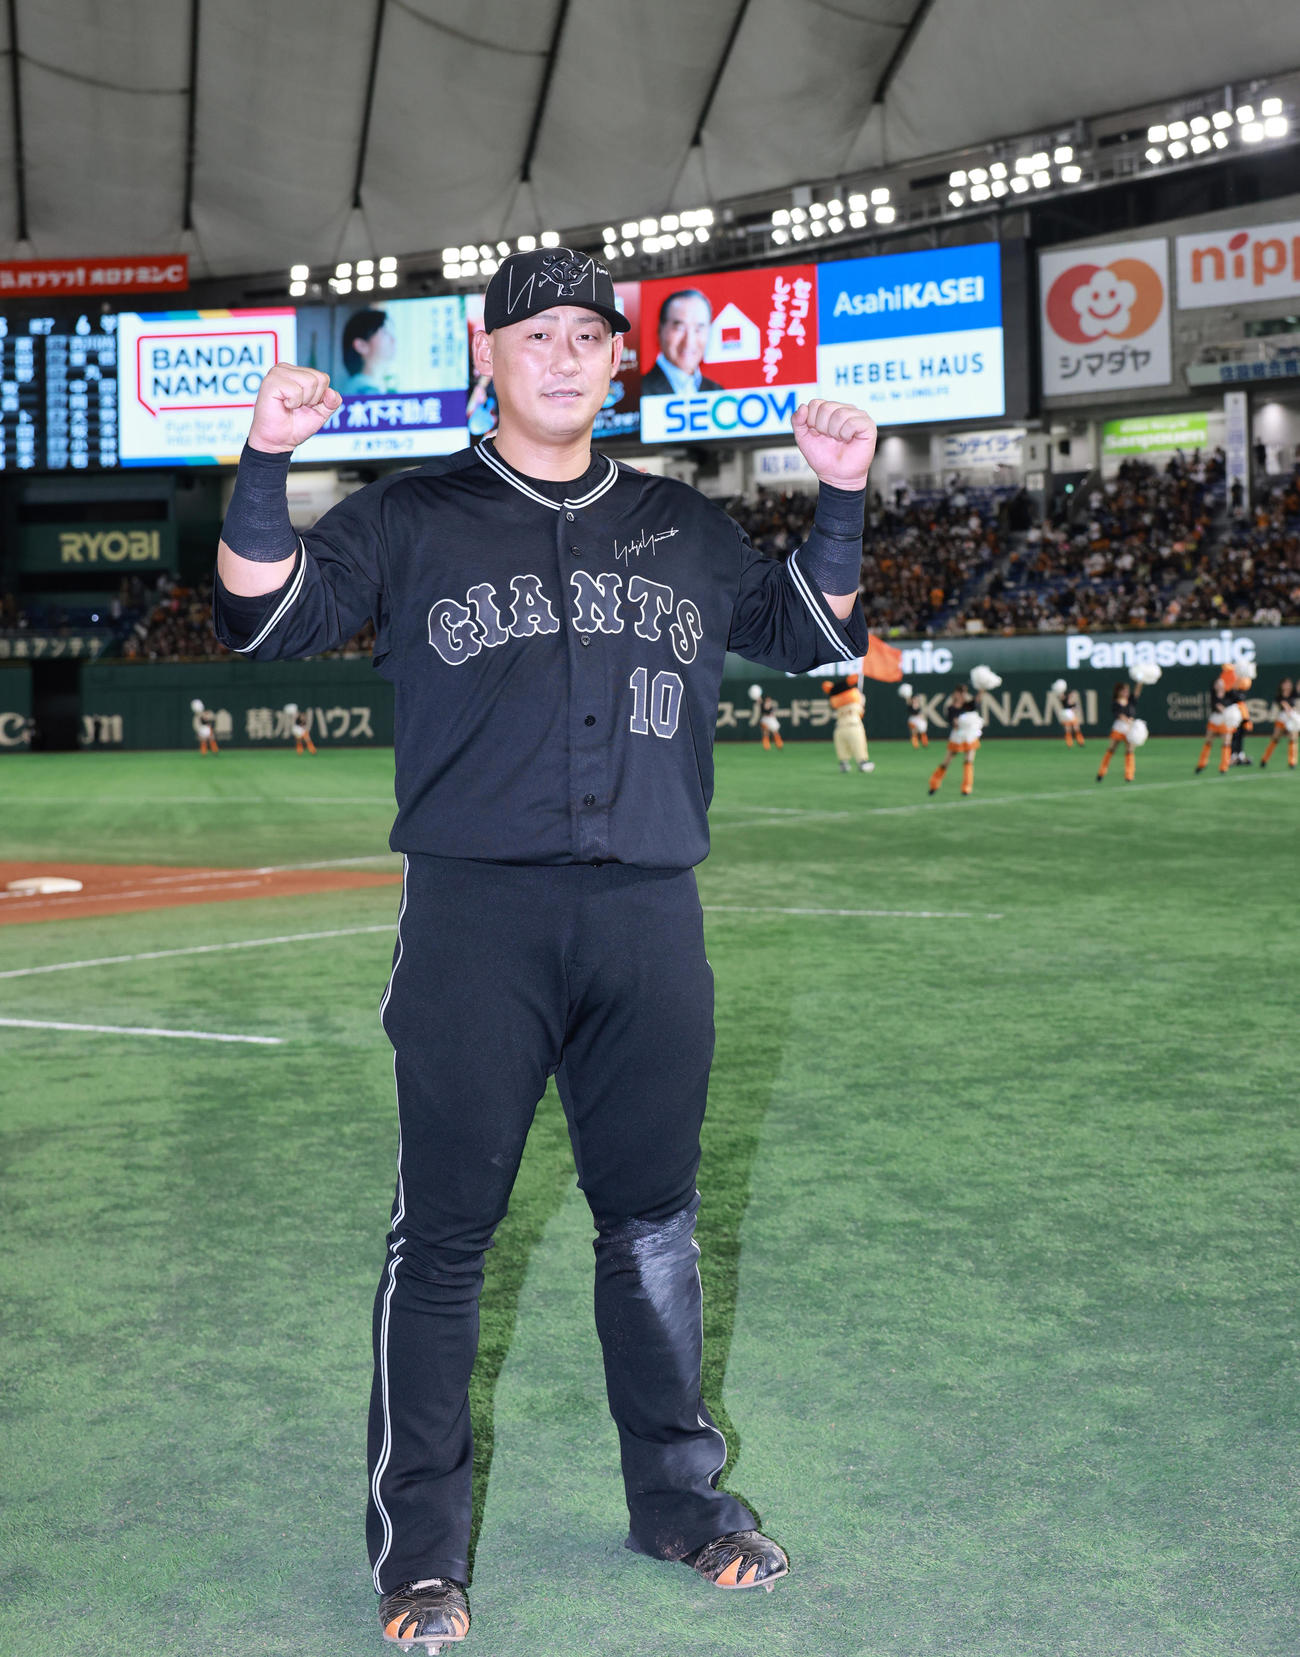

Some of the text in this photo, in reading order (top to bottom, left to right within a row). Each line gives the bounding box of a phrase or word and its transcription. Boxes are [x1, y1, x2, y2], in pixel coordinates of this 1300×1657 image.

[832, 275, 985, 317] AsahiKASEI
[152, 345, 264, 370] BANDAI
[835, 352, 984, 386] HEBEL HAUS
[1059, 345, 1151, 380] シマダヤ
[152, 371, 264, 397] NAMCO
[59, 531, 160, 562] RYOBI
[428, 570, 703, 666] GIANTS
[1066, 630, 1256, 669] Panasonic
[629, 666, 684, 739] 10
